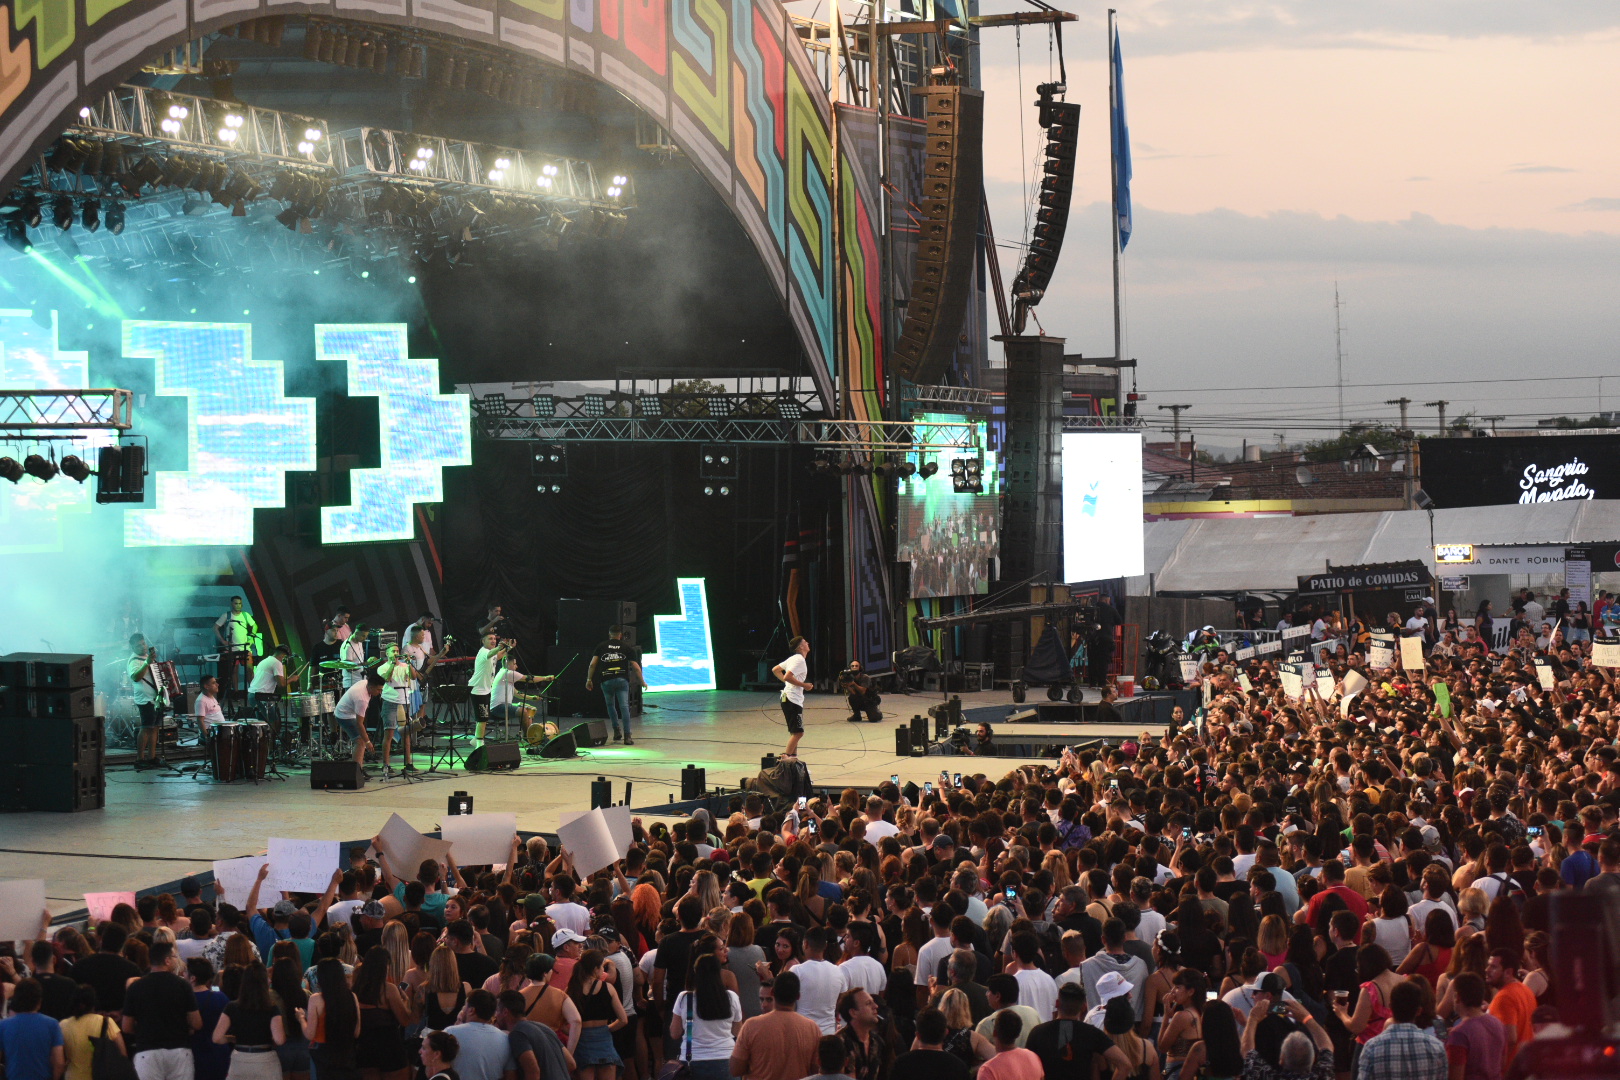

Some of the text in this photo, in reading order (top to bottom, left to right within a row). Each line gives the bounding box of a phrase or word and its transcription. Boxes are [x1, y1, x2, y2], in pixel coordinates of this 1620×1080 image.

[1519, 456, 1589, 490] Sangria
[1489, 557, 1520, 565] DANTE
[1310, 571, 1419, 590] PATIO de COMIDAS
